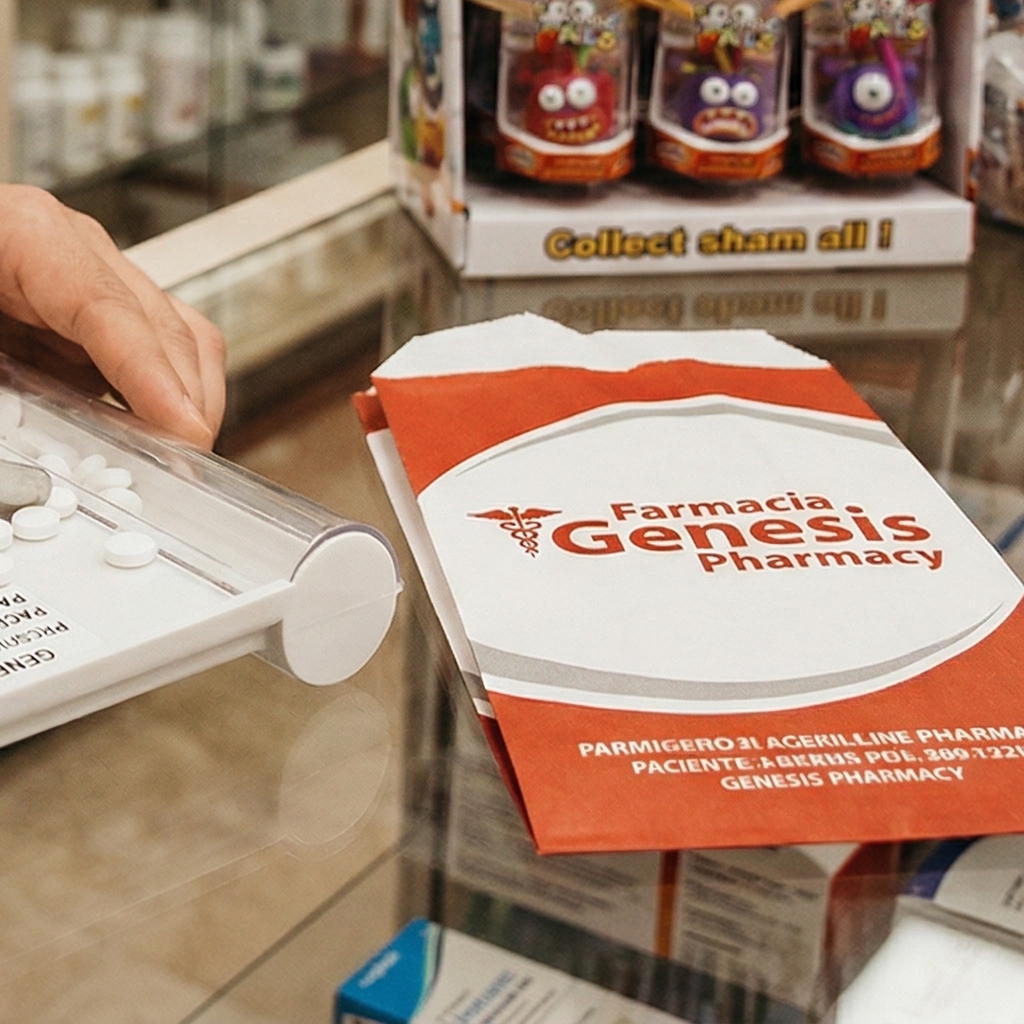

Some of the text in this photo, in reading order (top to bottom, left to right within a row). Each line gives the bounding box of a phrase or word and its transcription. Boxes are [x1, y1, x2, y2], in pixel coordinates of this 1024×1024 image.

[543, 226, 687, 261] Collect
[817, 219, 868, 251] all
[610, 491, 835, 522] Farmacia
[551, 506, 932, 556] Genesis
[696, 548, 944, 574] Pharmacy
[720, 766, 964, 791] GENESIS PHARMACY
